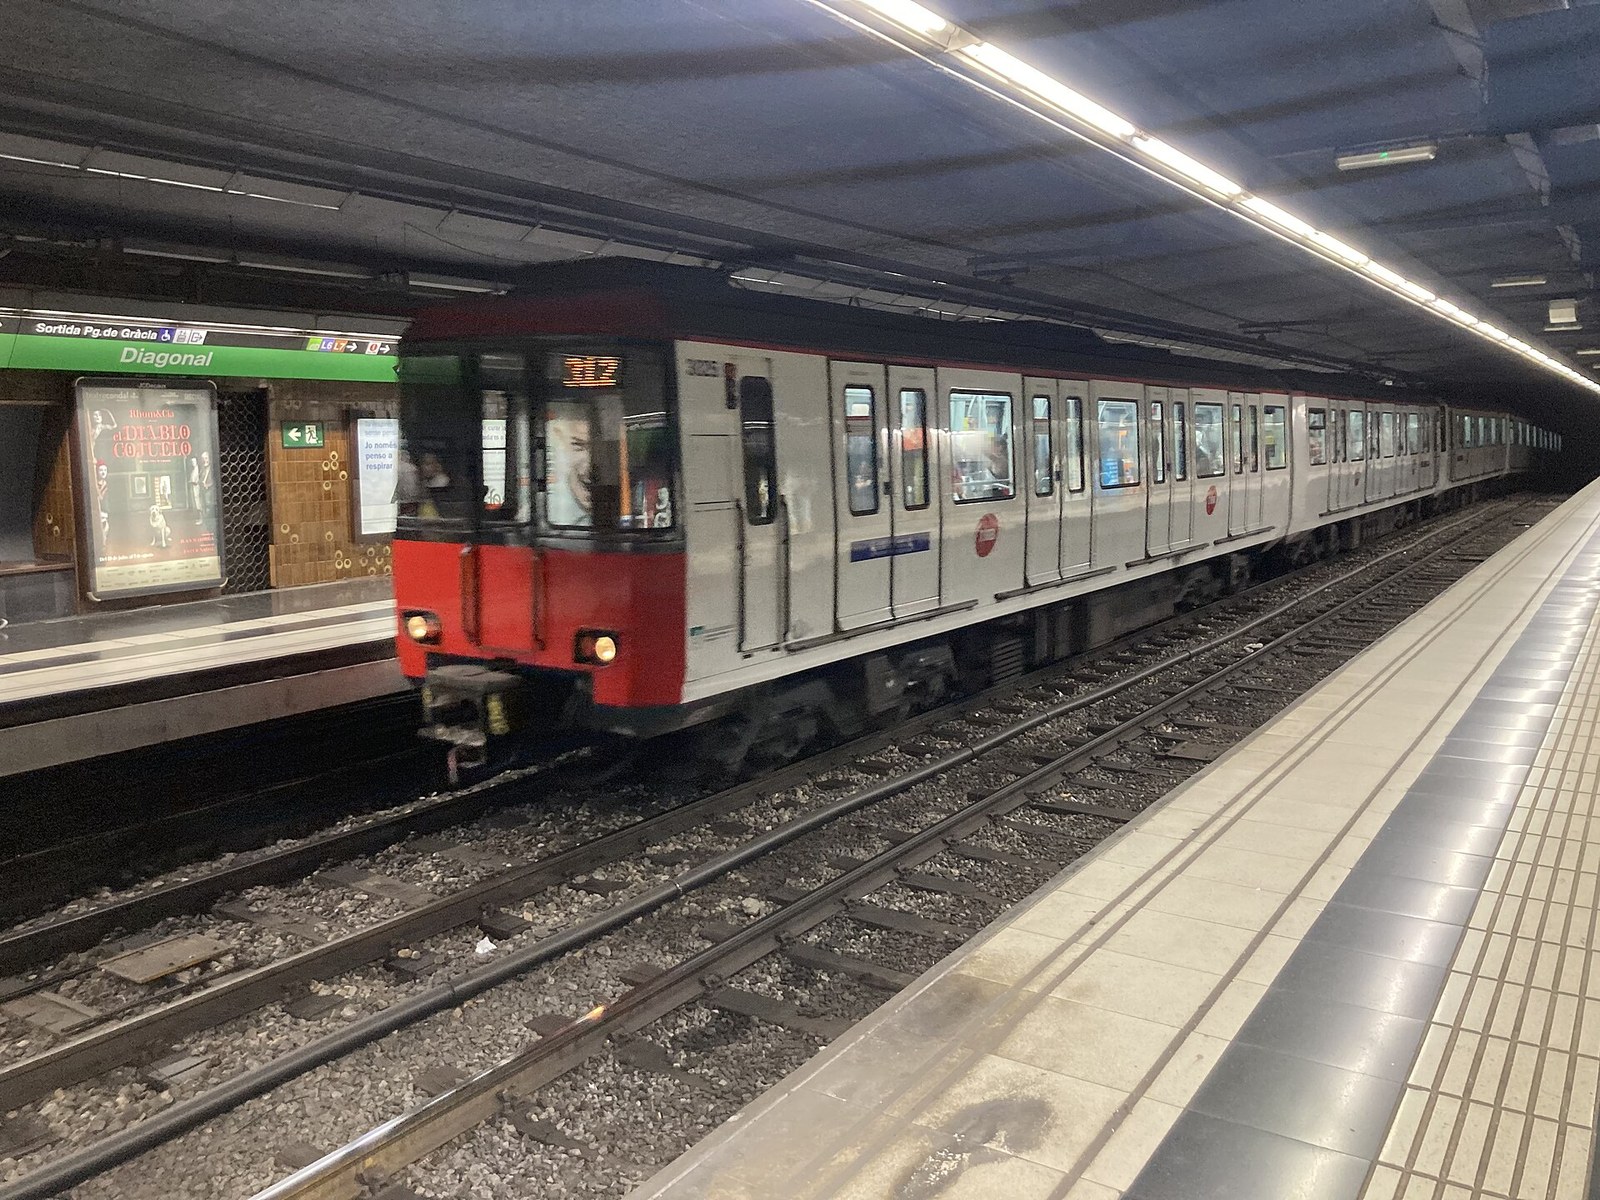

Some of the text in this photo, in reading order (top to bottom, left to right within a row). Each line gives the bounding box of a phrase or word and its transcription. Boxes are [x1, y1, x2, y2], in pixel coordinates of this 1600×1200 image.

[35, 322, 81, 335] Sortida
[121, 327, 158, 340] Gràcia
[321, 342, 333, 350] L6
[333, 342, 345, 351] L7
[120, 347, 214, 368] Diagonal
[123, 424, 191, 440] DIABLO
[113, 441, 192, 458] COJUELO
[365, 441, 373, 449] Jo
[365, 452, 386, 461] penso
[366, 462, 393, 471] respirar
